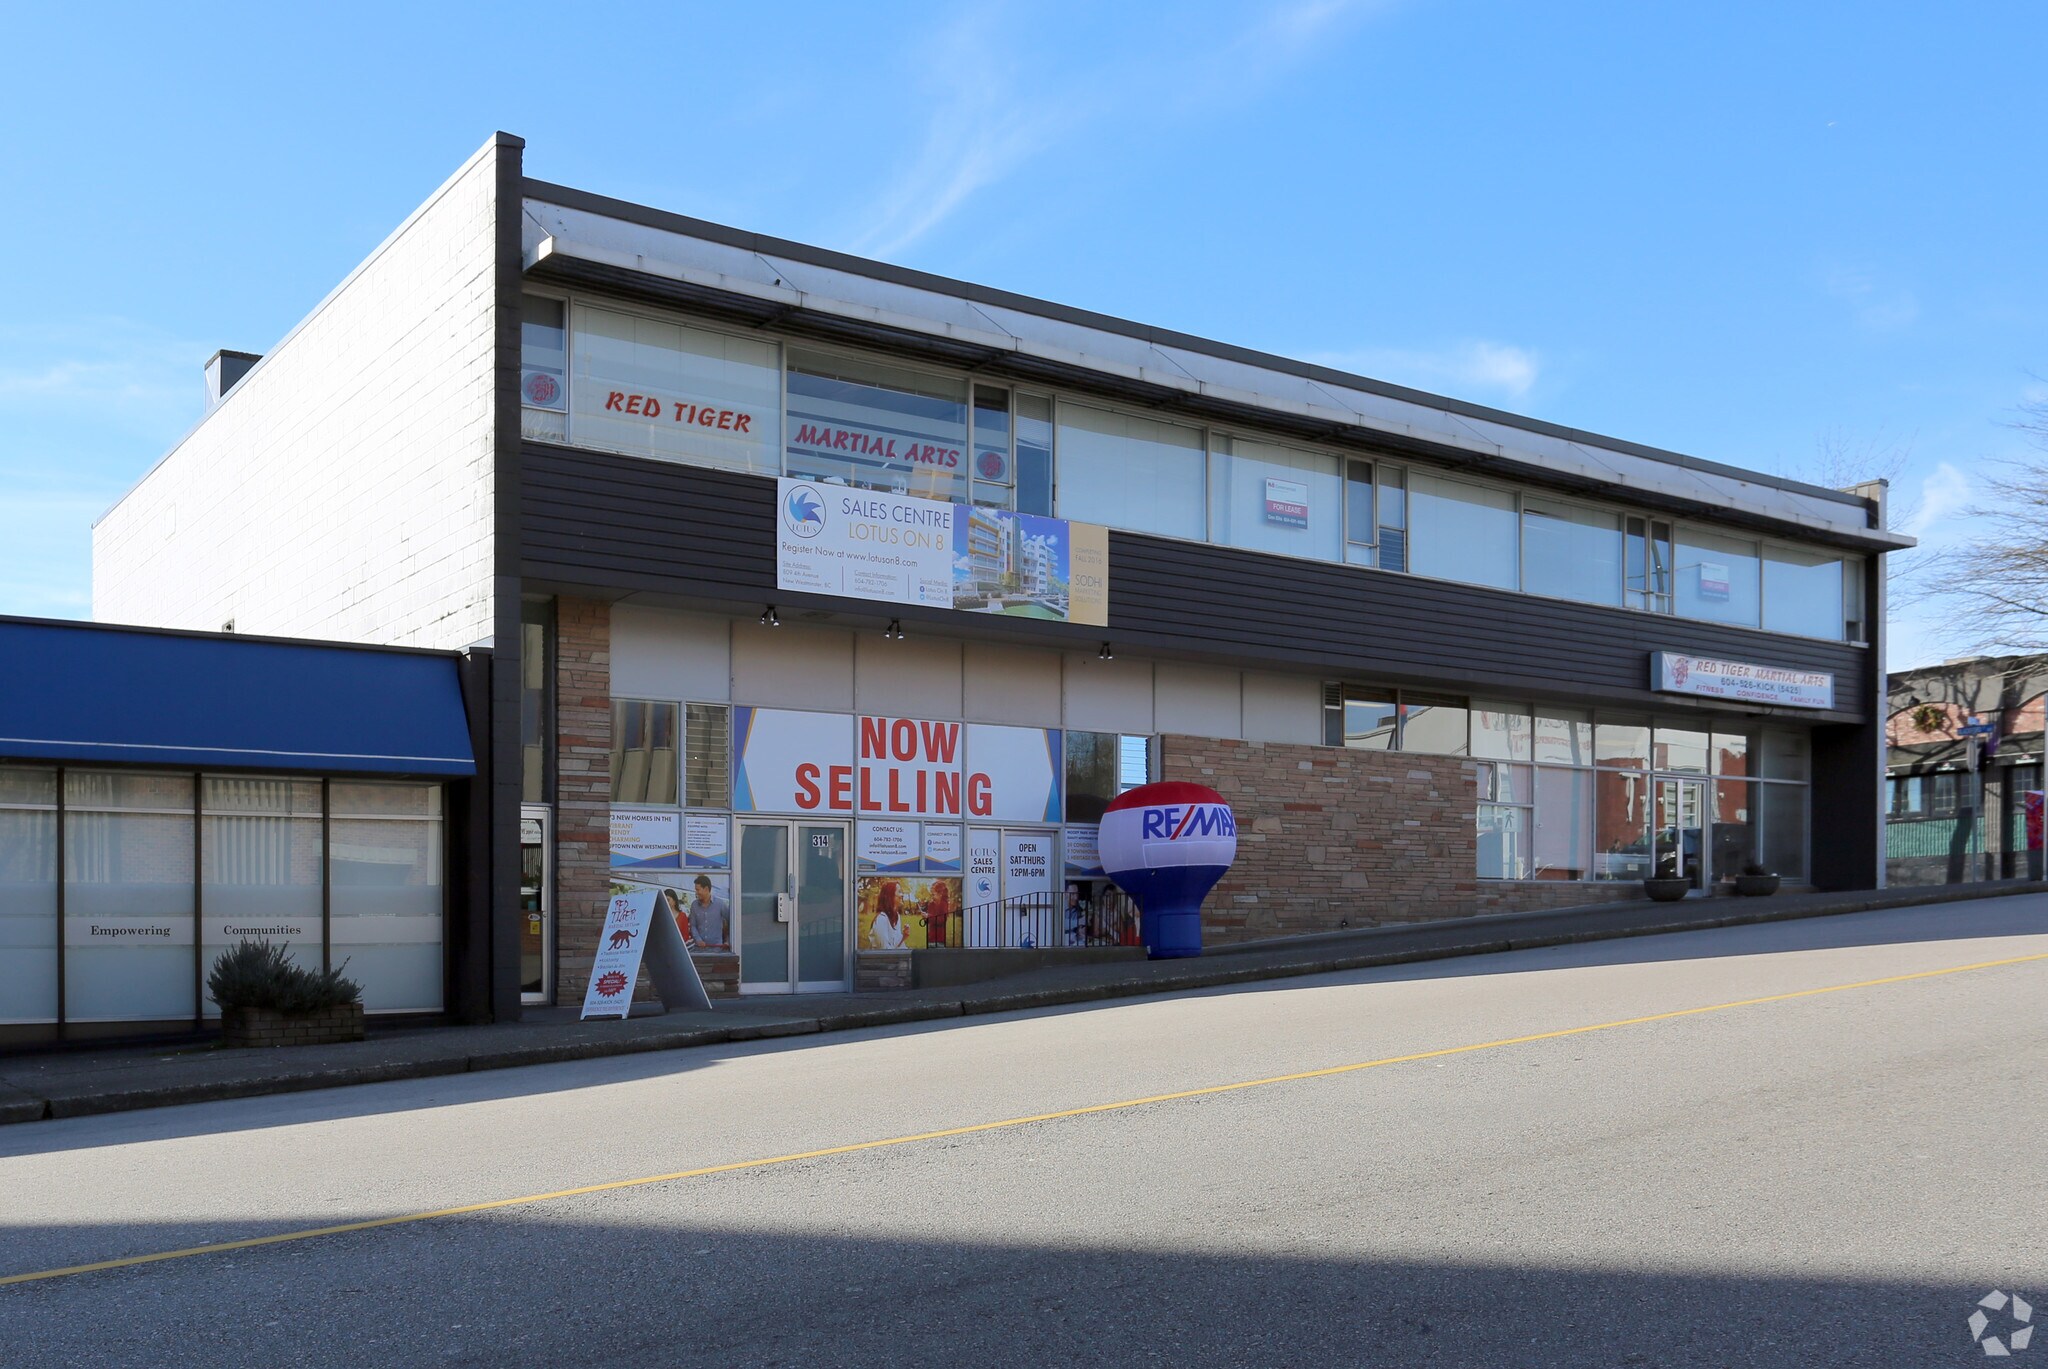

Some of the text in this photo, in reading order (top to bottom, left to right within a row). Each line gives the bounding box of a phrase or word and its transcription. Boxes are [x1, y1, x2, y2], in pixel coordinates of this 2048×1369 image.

[605, 391, 751, 433] RED TIGER
[795, 424, 960, 468] MARTIAL ARTS
[842, 498, 951, 529] SALES CENTRE
[1273, 503, 1302, 514] FOR LEASE
[792, 523, 817, 533] LOTUS
[850, 522, 944, 551] LOTUS ON 8
[782, 542, 918, 568] Register Now at www.lotuson8.com
[1075, 554, 1087, 563] FALL
[1075, 574, 1103, 588] SODHI
[1696, 660, 1825, 687] RED TIGER MARTIAL ARTS
[1696, 684, 1724, 694] FITNESS
[1736, 690, 1778, 700] CONFIDENCE
[861, 716, 960, 764] NOW
[795, 763, 992, 816] SELLING
[1142, 805, 1237, 840] RE/MAX
[813, 835, 828, 847] 314
[1019, 843, 1037, 853] OPEN
[971, 848, 997, 857] LOTUS
[1010, 856, 1046, 865] SAT-THURS
[970, 866, 996, 874] CENTRE
[1010, 868, 1046, 877] 12PM-6PM
[90, 925, 301, 937] Empowering Communities
